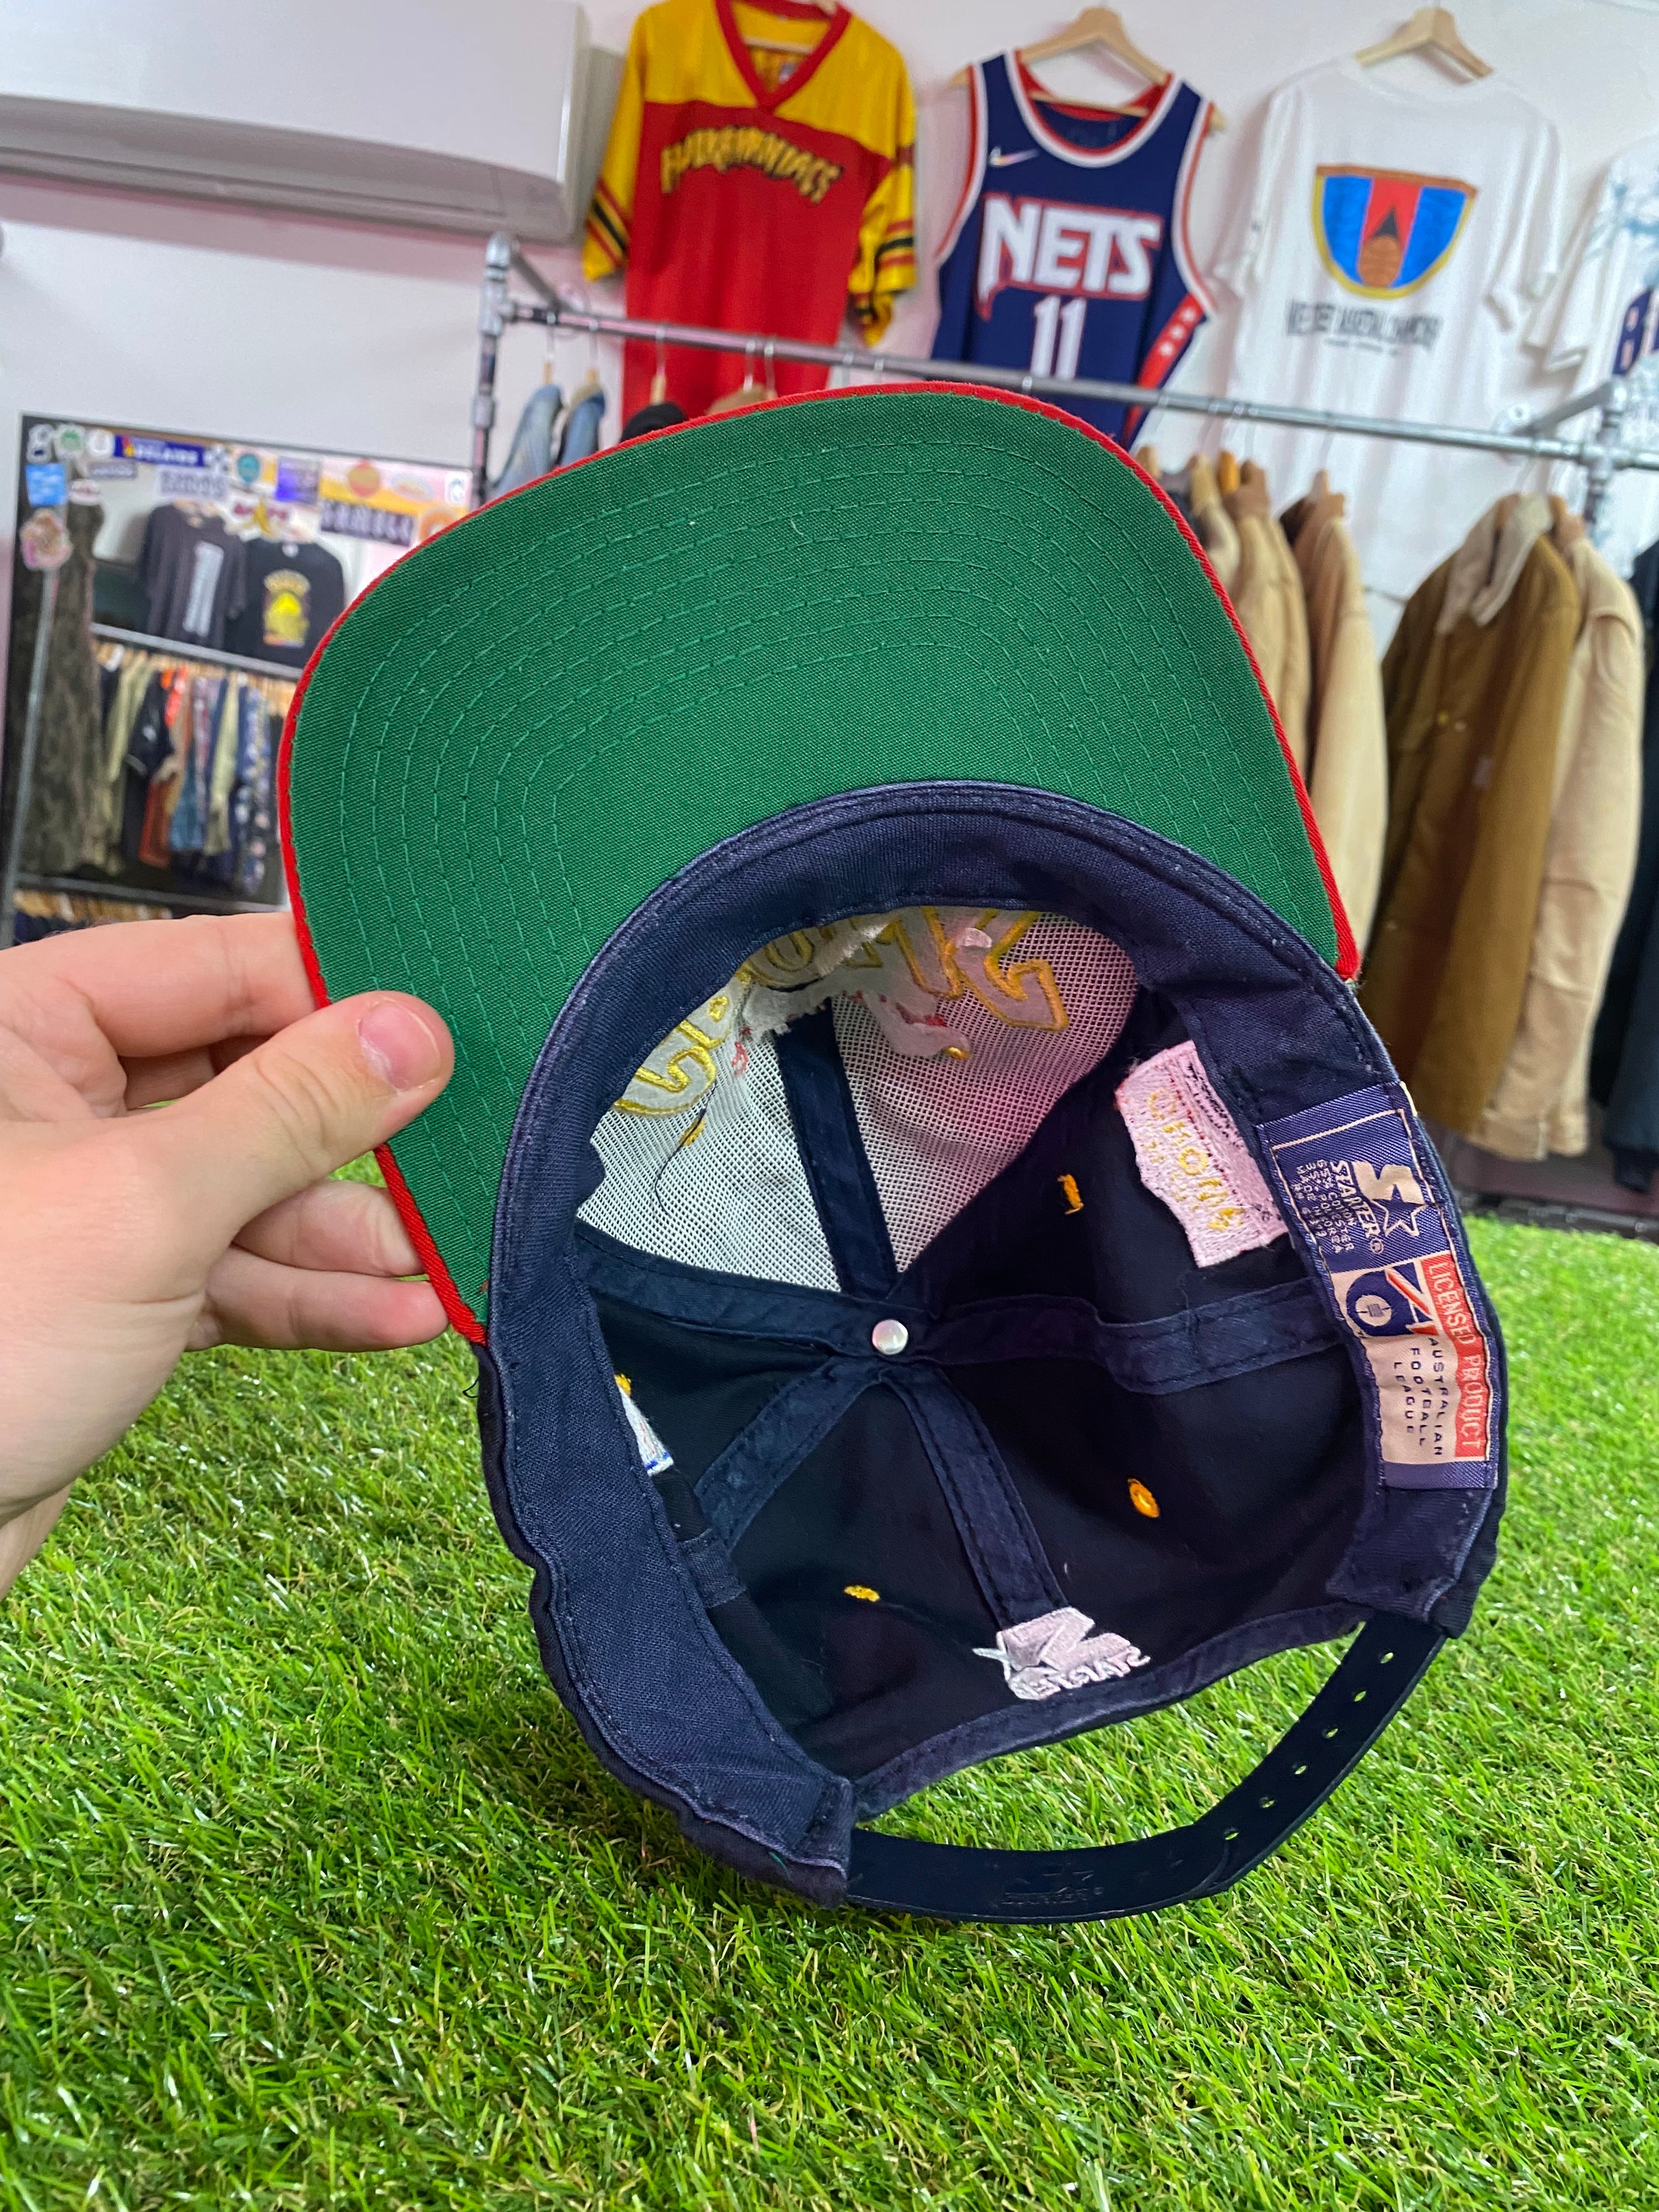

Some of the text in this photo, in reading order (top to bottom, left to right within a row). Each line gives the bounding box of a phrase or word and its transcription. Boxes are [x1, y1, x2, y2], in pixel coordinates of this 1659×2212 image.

[974, 191, 1164, 323] NETS
[1030, 294, 1087, 379] 11
[1296, 1165, 1317, 1201] MADE
[1312, 1206, 1324, 1216] IN
[1318, 1193, 1355, 1251] POLYESTER
[1328, 1192, 1357, 1226] COTTON
[1394, 1361, 1416, 1433] LEAGUE
[1410, 1347, 1432, 1446] FOOTBALL
[1428, 1261, 1485, 1450] LICENSED PRODUCT
[1428, 1337, 1449, 1455] AUSTRALIAN
